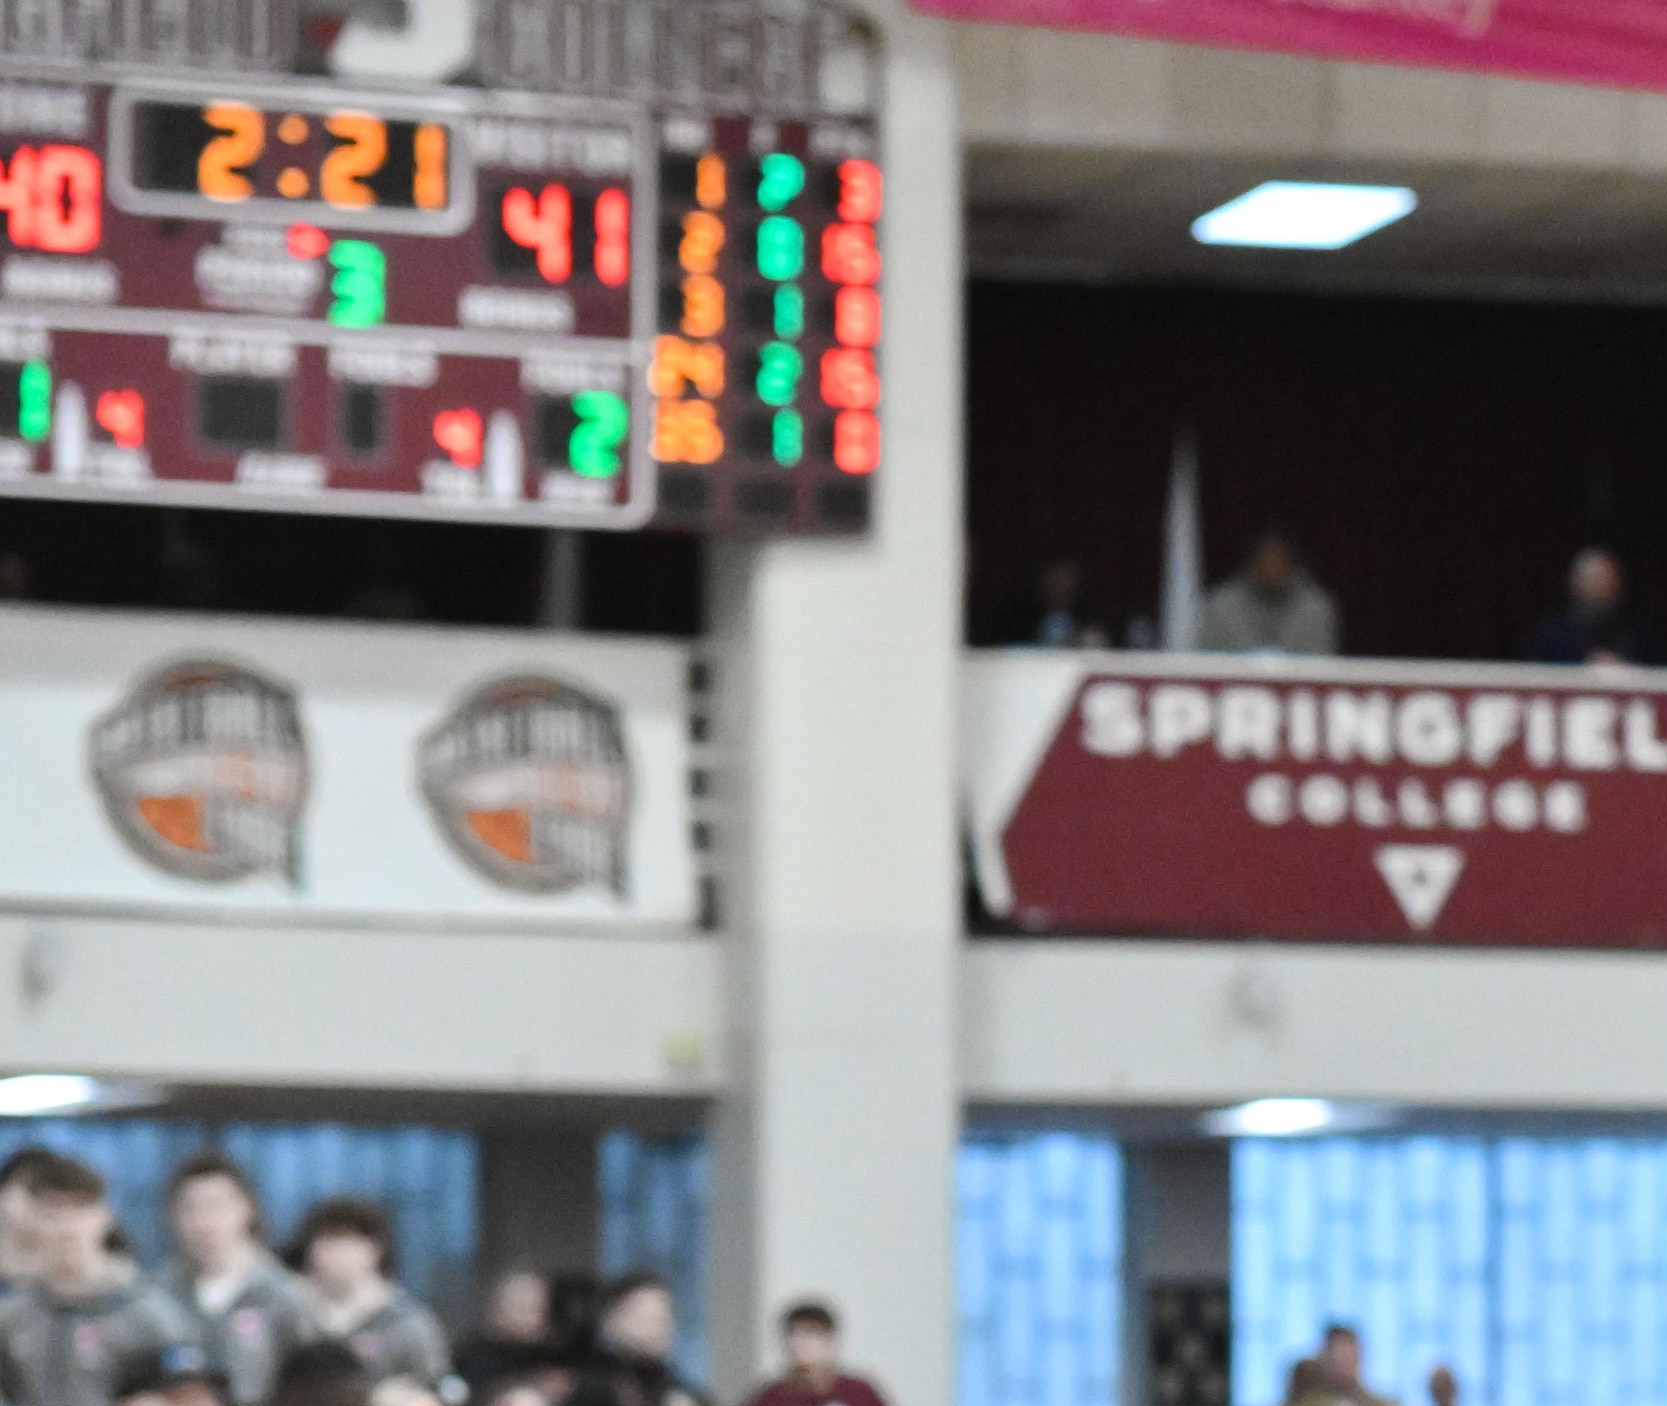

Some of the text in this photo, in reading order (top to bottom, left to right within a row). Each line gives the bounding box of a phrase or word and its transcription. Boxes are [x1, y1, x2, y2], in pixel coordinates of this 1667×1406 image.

[198, 100, 448, 212] 2:21
[501, 182, 631, 289] 41
[327, 239, 388, 329] 3
[567, 390, 629, 480] 2
[1244, 771, 1589, 836] COLLEGE
